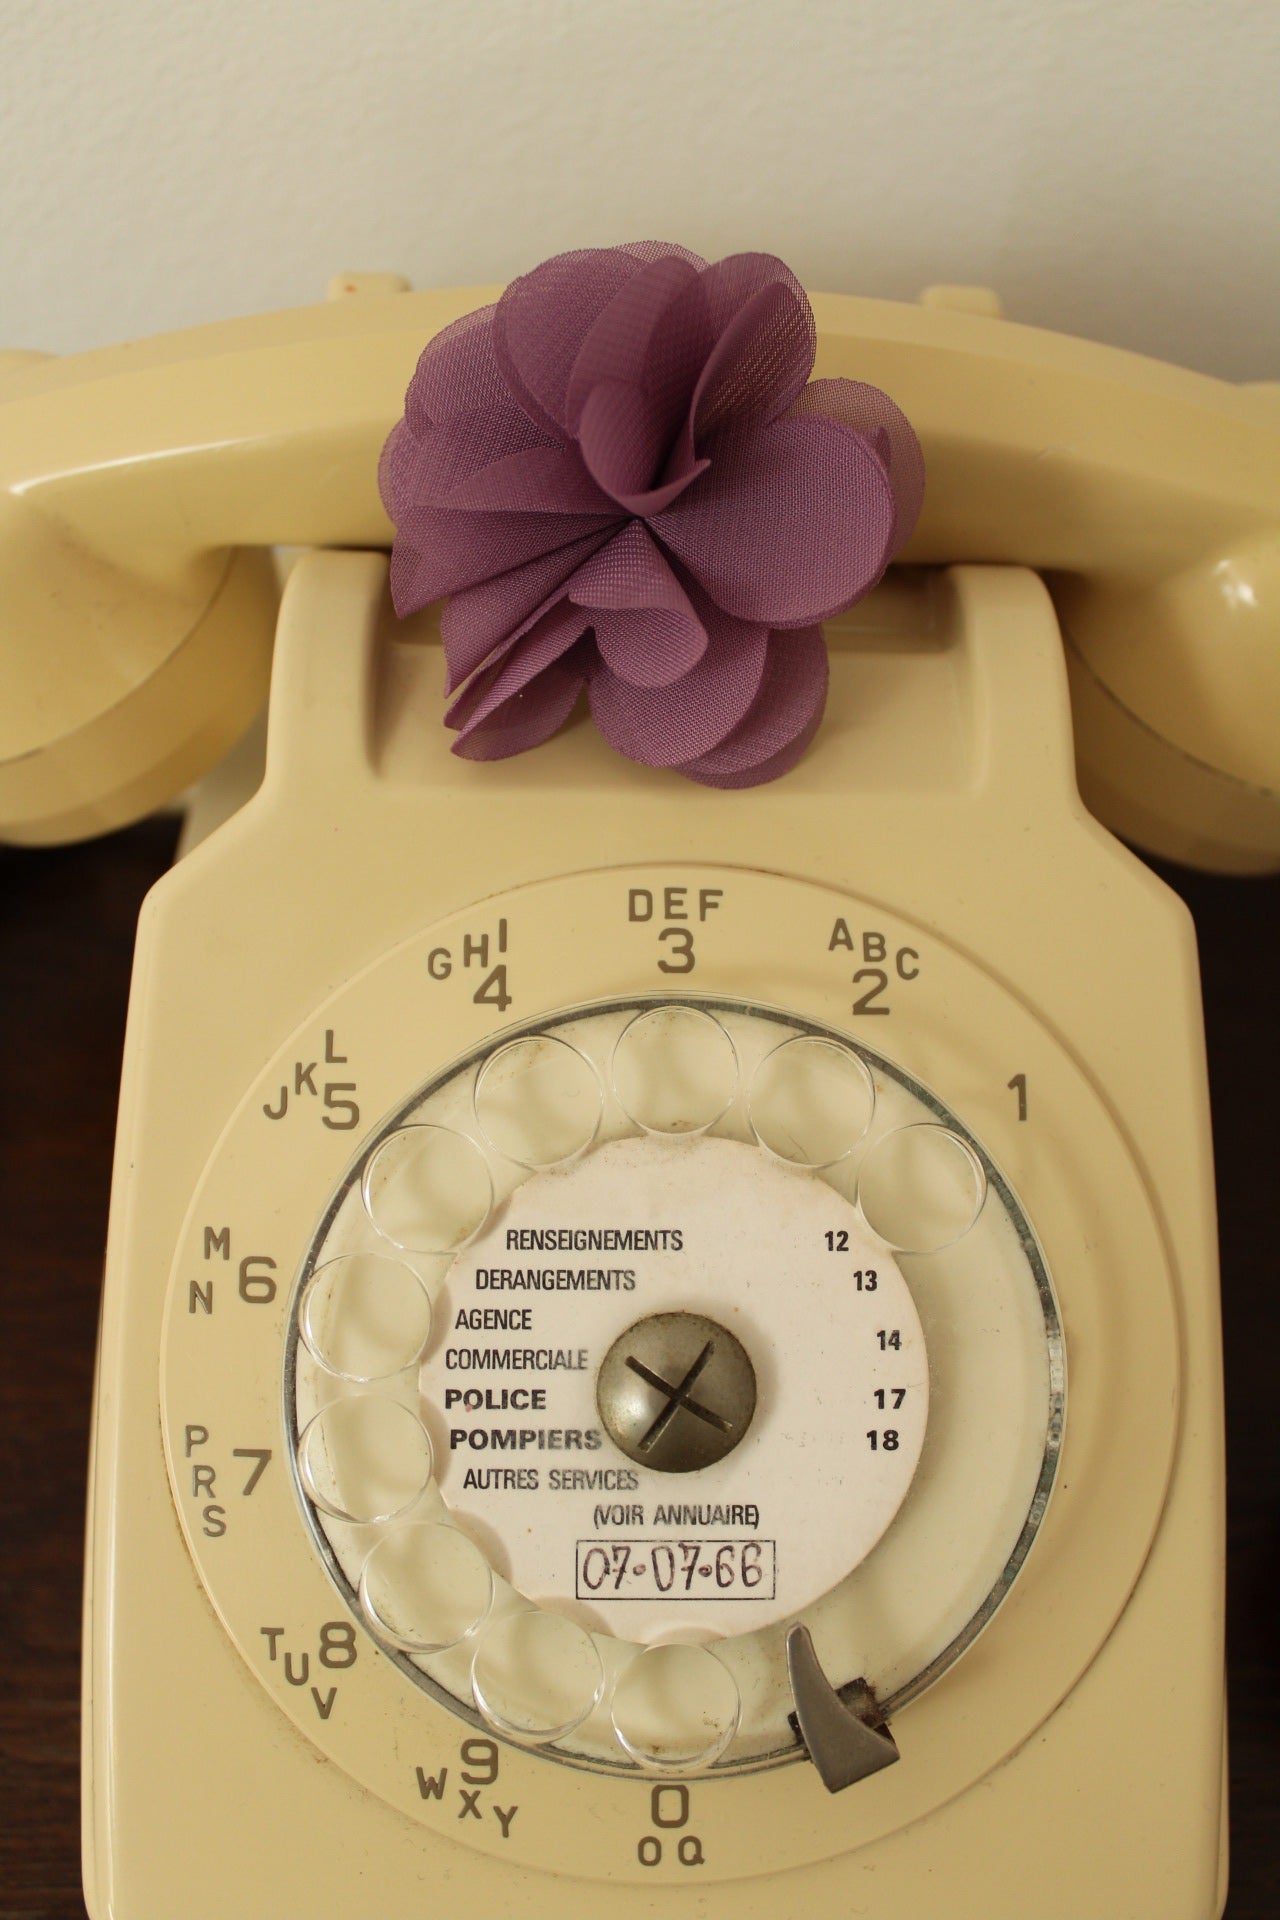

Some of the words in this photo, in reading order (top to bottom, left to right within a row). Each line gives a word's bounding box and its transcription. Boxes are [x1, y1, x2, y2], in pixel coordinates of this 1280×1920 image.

[629, 887, 723, 922] DEF
[658, 928, 695, 974] 3
[473, 967, 512, 1011] 4
[853, 969, 890, 1015] 2
[322, 1083, 359, 1130] 5
[1008, 1074, 1027, 1121] 1
[507, 1230, 683, 1251] RENSEIGNEMENTS
[825, 1231, 849, 1251] 12
[239, 1259, 277, 1304] 6
[476, 1269, 635, 1290] DERANGEMENTS
[854, 1270, 877, 1291] 13
[455, 1309, 532, 1330] AGENCE
[877, 1330, 902, 1350] 14
[446, 1349, 587, 1370] COMMERCIALE
[445, 1389, 546, 1410] POLICE
[874, 1389, 906, 1409] 17
[450, 1429, 602, 1450] POMPIERS
[867, 1430, 899, 1451] 18
[233, 1449, 272, 1496] 7
[463, 1469, 538, 1490] AUTRES
[549, 1469, 639, 1490] SERVICES
[594, 1505, 643, 1529] (VOIR
[654, 1504, 759, 1529] ANNUAIRE)
[318, 1622, 357, 1669] 8
[460, 1739, 498, 1784] 9
